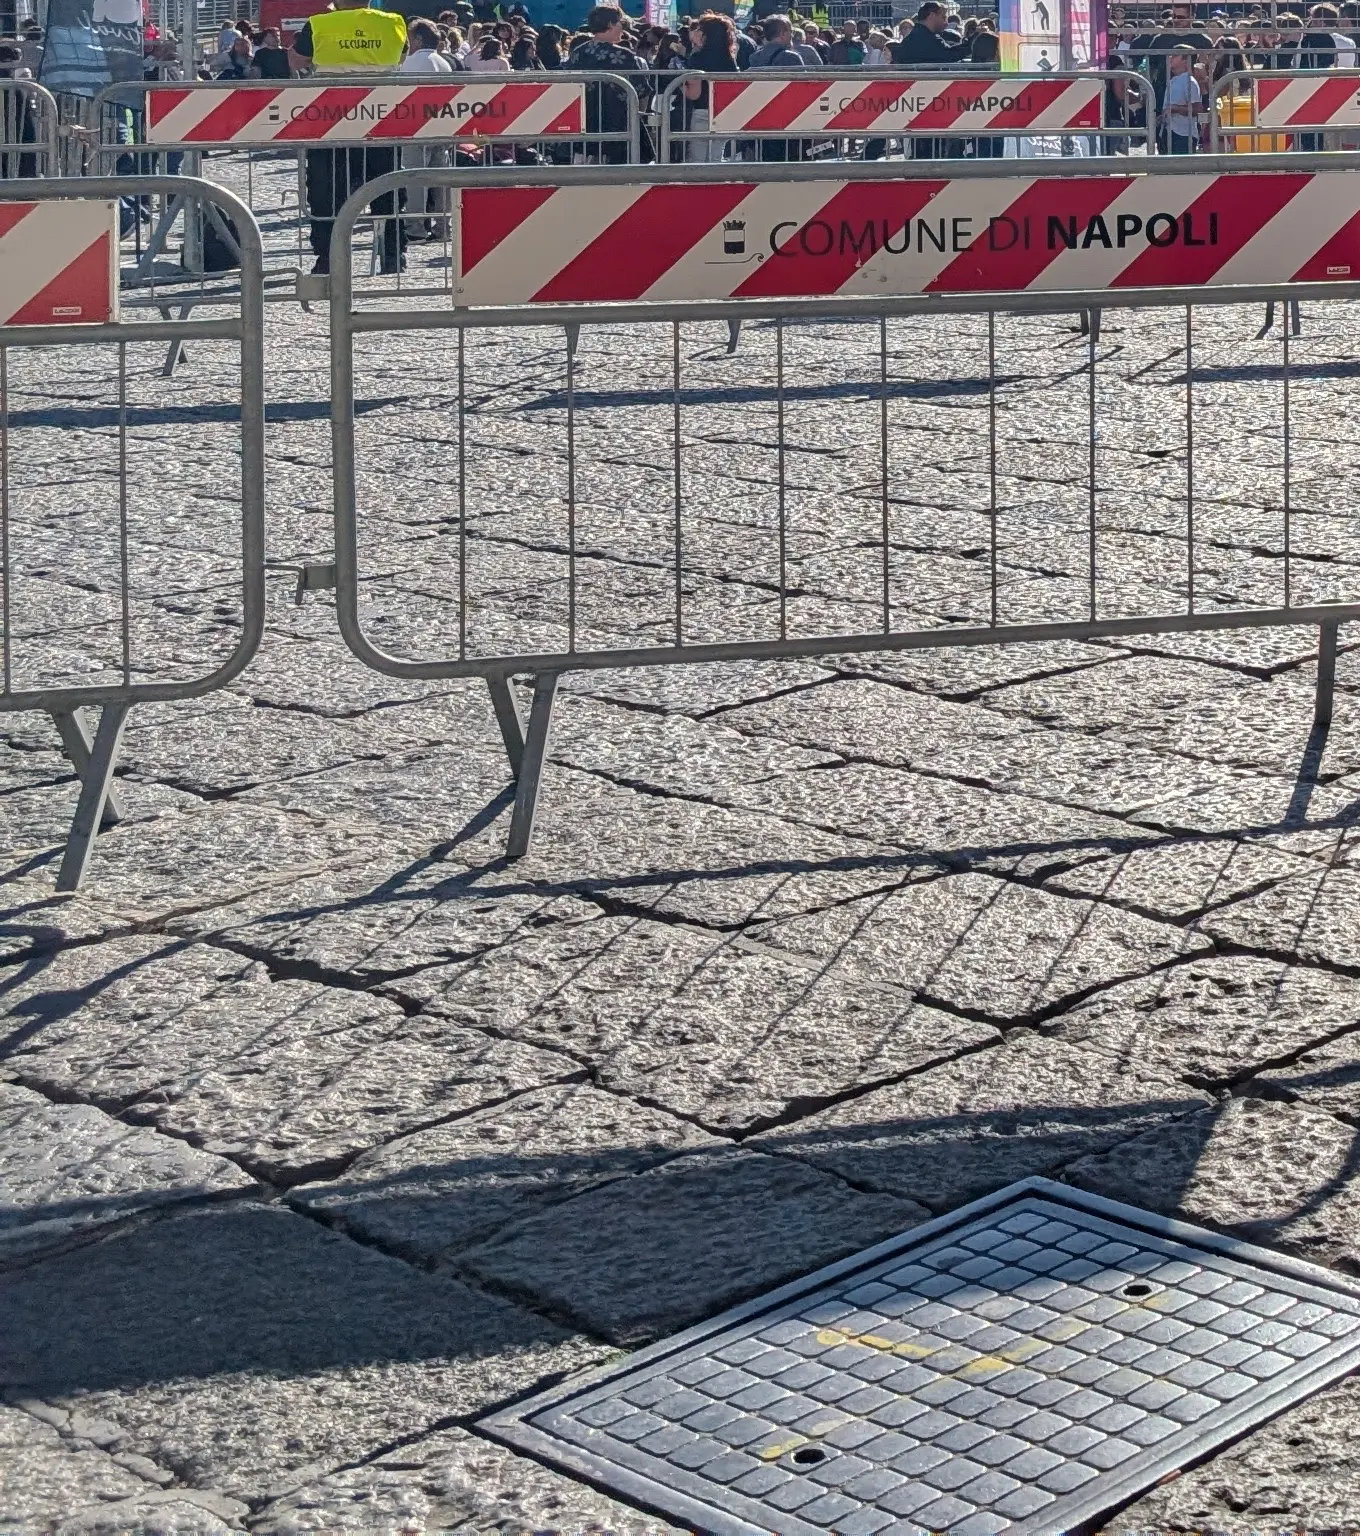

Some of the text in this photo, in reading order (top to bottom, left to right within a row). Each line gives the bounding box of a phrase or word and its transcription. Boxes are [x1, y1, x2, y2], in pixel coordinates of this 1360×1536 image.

[339, 40, 382, 50] SECURITY
[290, 101, 508, 123] COMUNE DI NAPOLI
[838, 95, 1032, 114] COMUNE DI NAPOLI
[769, 213, 1219, 257] COMUNE DI NAPOLI
